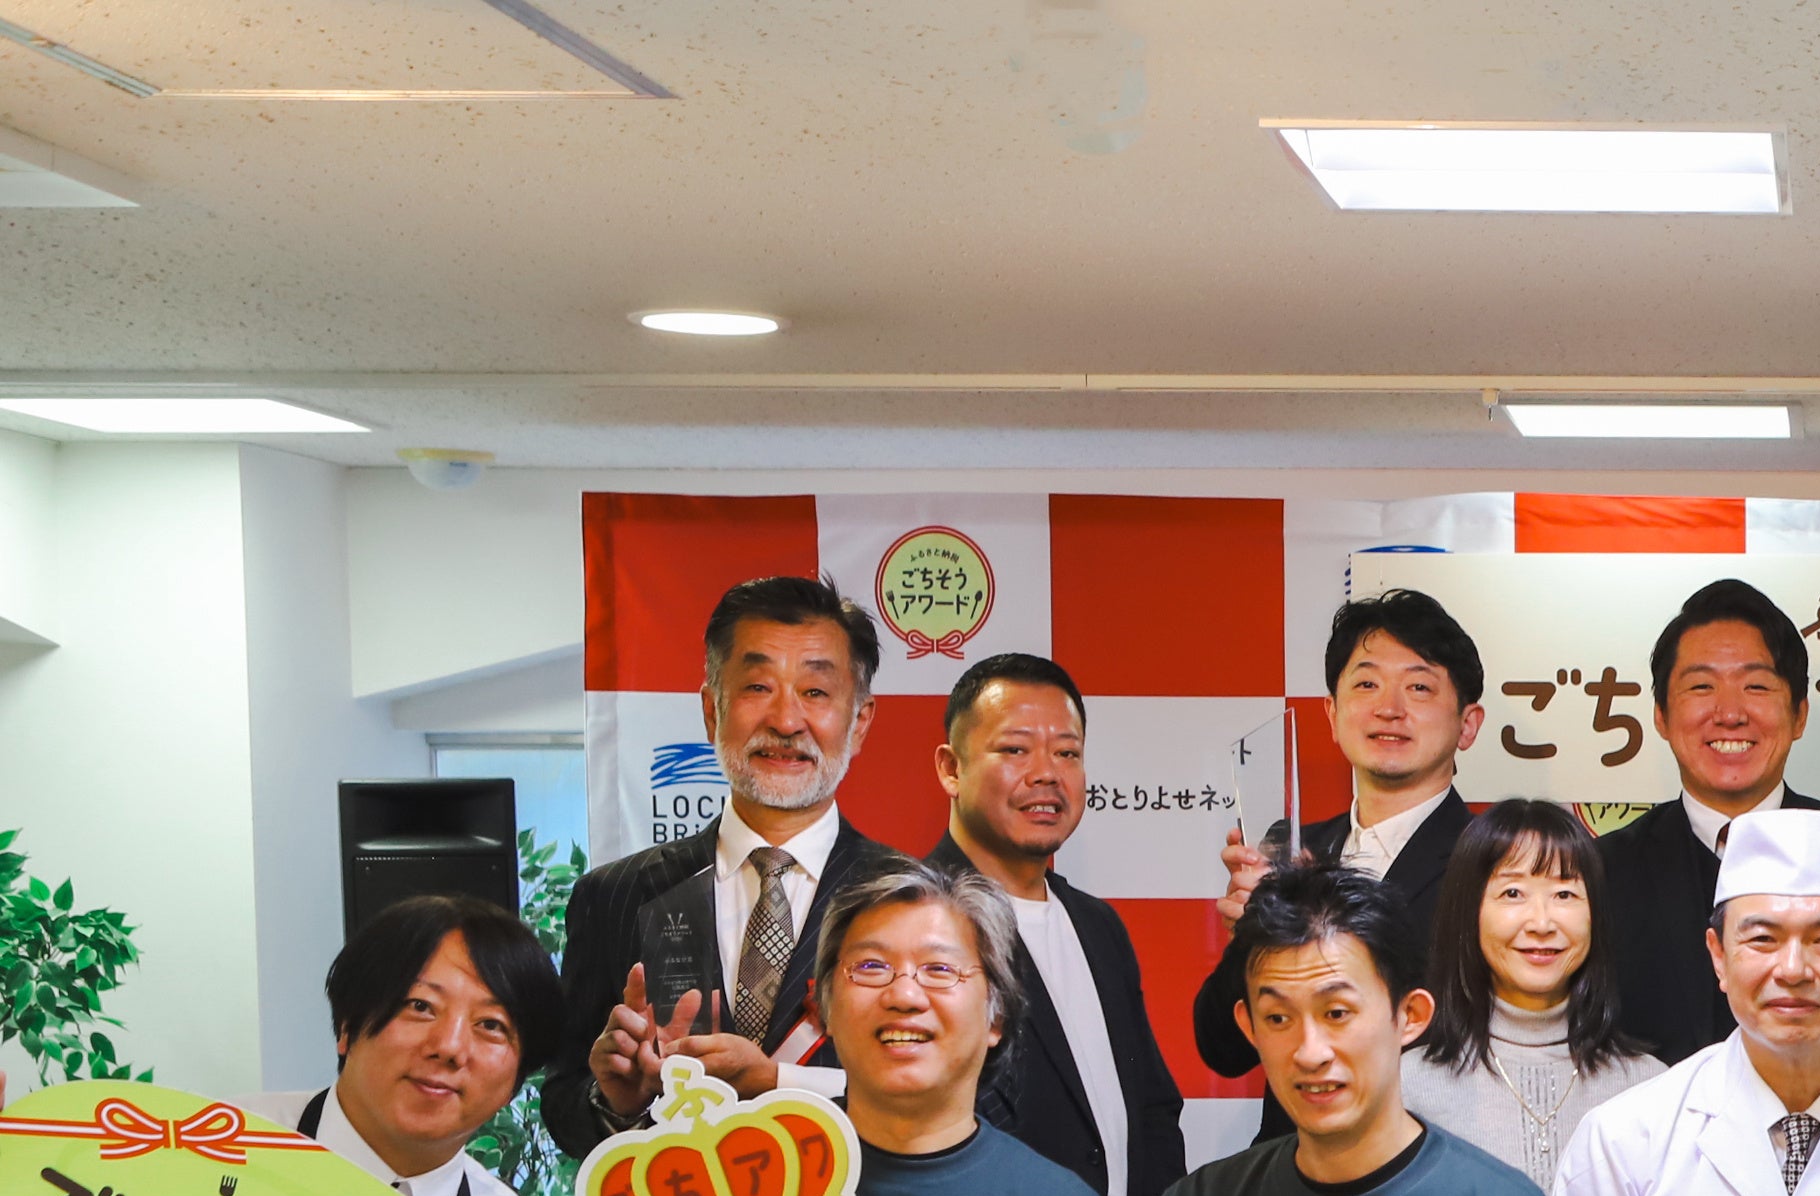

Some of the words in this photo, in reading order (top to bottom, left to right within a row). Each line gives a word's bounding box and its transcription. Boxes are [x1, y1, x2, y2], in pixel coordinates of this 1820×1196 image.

[902, 567, 967, 590] ごちそう
[900, 594, 970, 615] アワード
